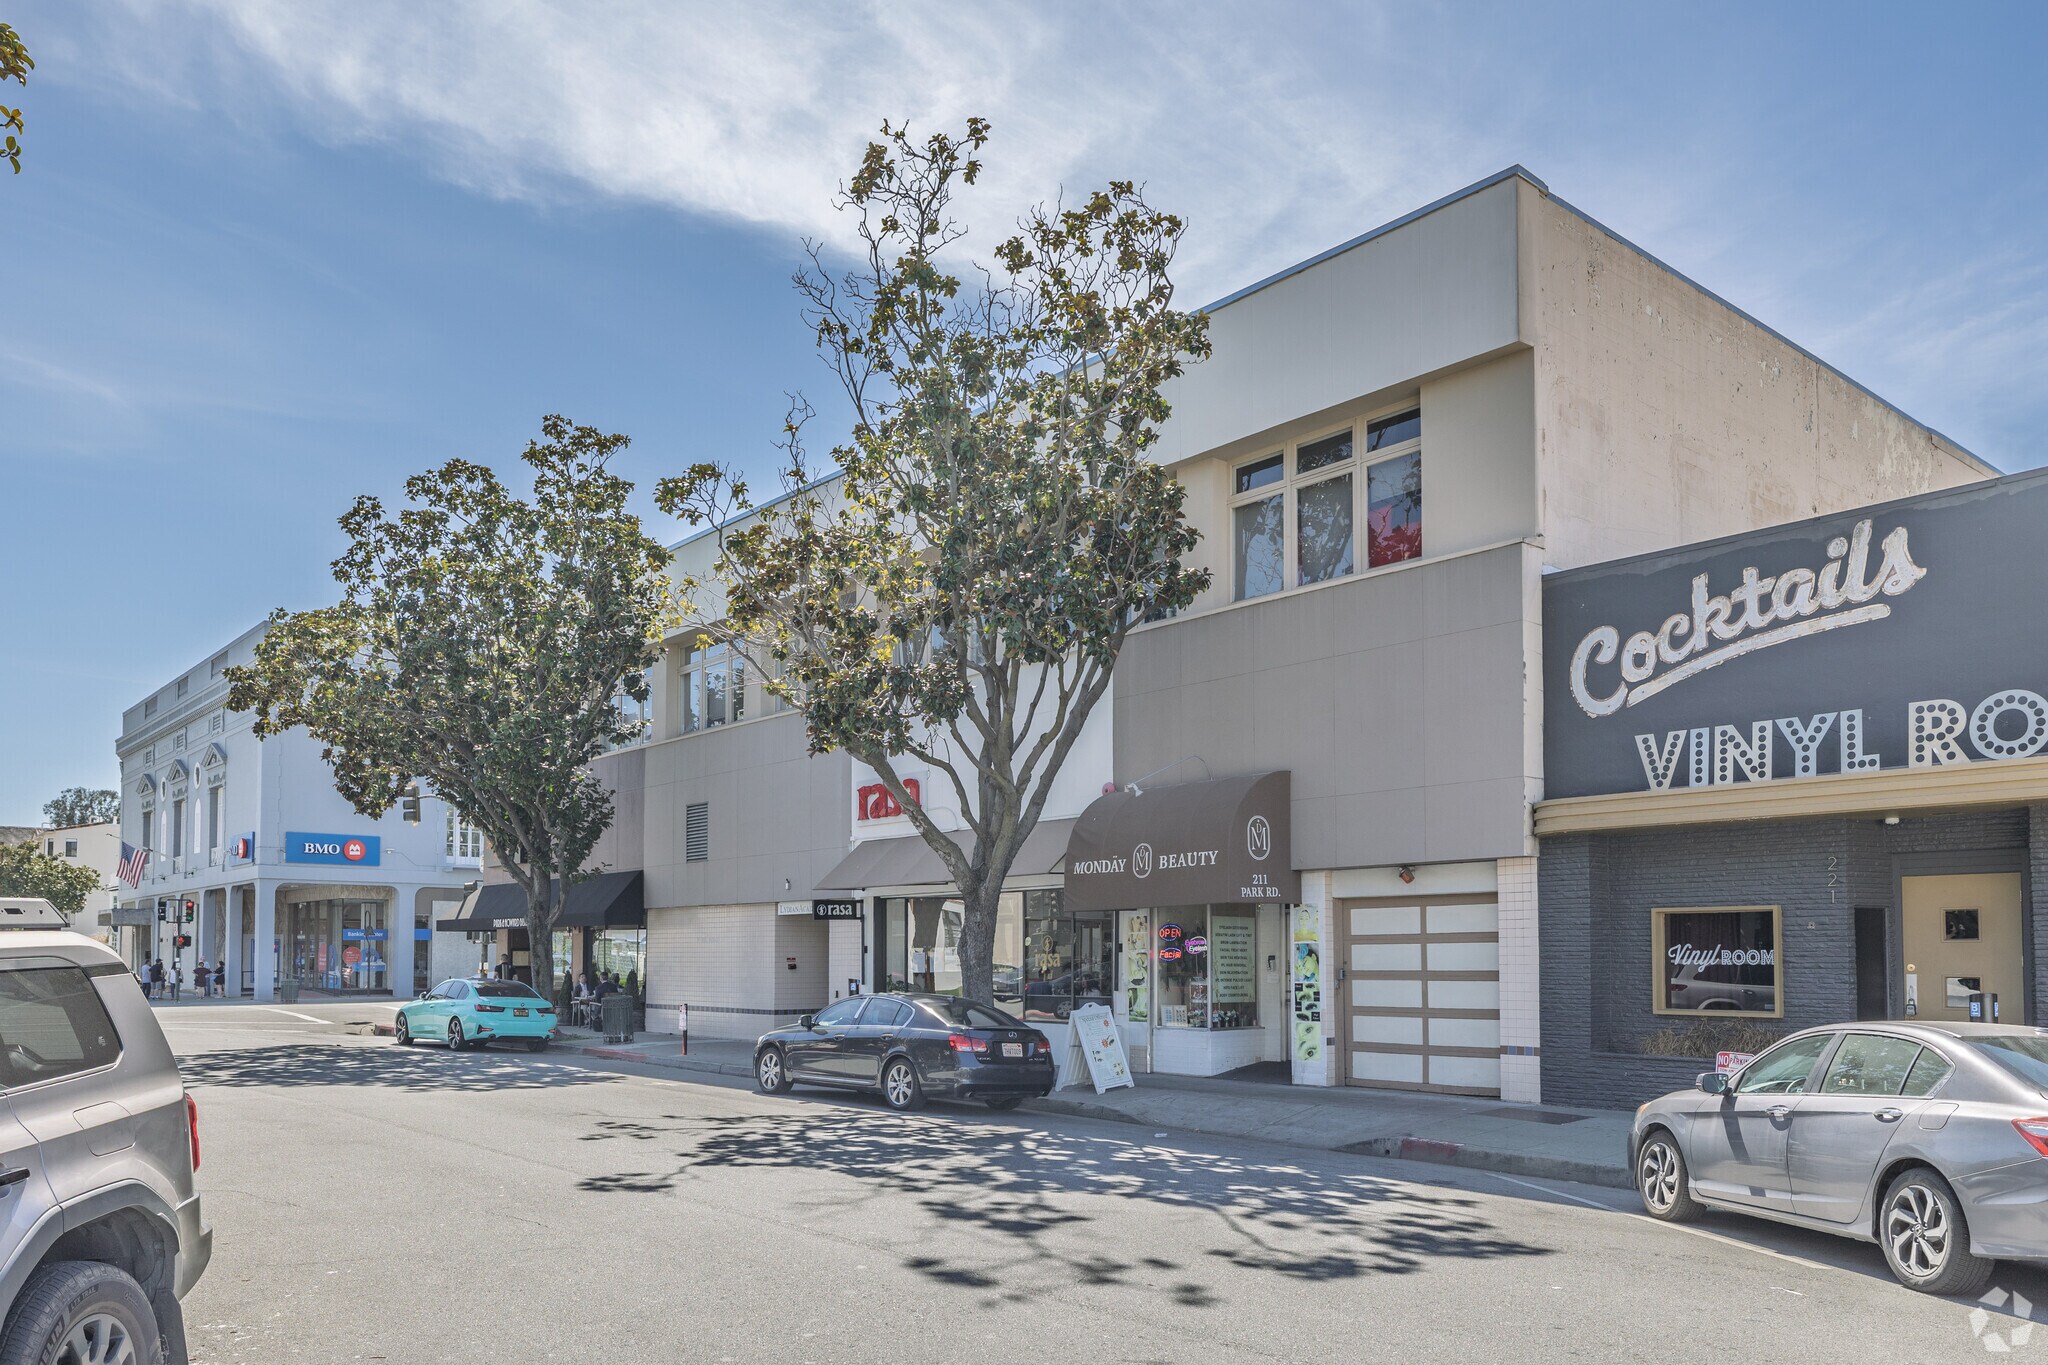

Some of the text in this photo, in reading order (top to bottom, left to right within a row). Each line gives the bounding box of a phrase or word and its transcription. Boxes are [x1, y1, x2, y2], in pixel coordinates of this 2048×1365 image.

[1569, 519, 1927, 719] Cocktails
[1635, 708, 1880, 792] VINYL
[304, 842, 340, 855] BMO
[1159, 850, 1219, 870] BEAUTY
[1252, 874, 1268, 885] 211
[1827, 856, 1838, 904] 221
[1241, 887, 1281, 898] PARK RD.
[827, 903, 853, 916] rasa
[1159, 928, 1181, 938] OPEN
[1034, 954, 1060, 967] rasa
[1160, 950, 1182, 958] Facial
[1668, 943, 1775, 973] Vinyl ROOM
[1718, 1055, 1729, 1066] NO
[82, 1286, 97, 1298] TRAIL
